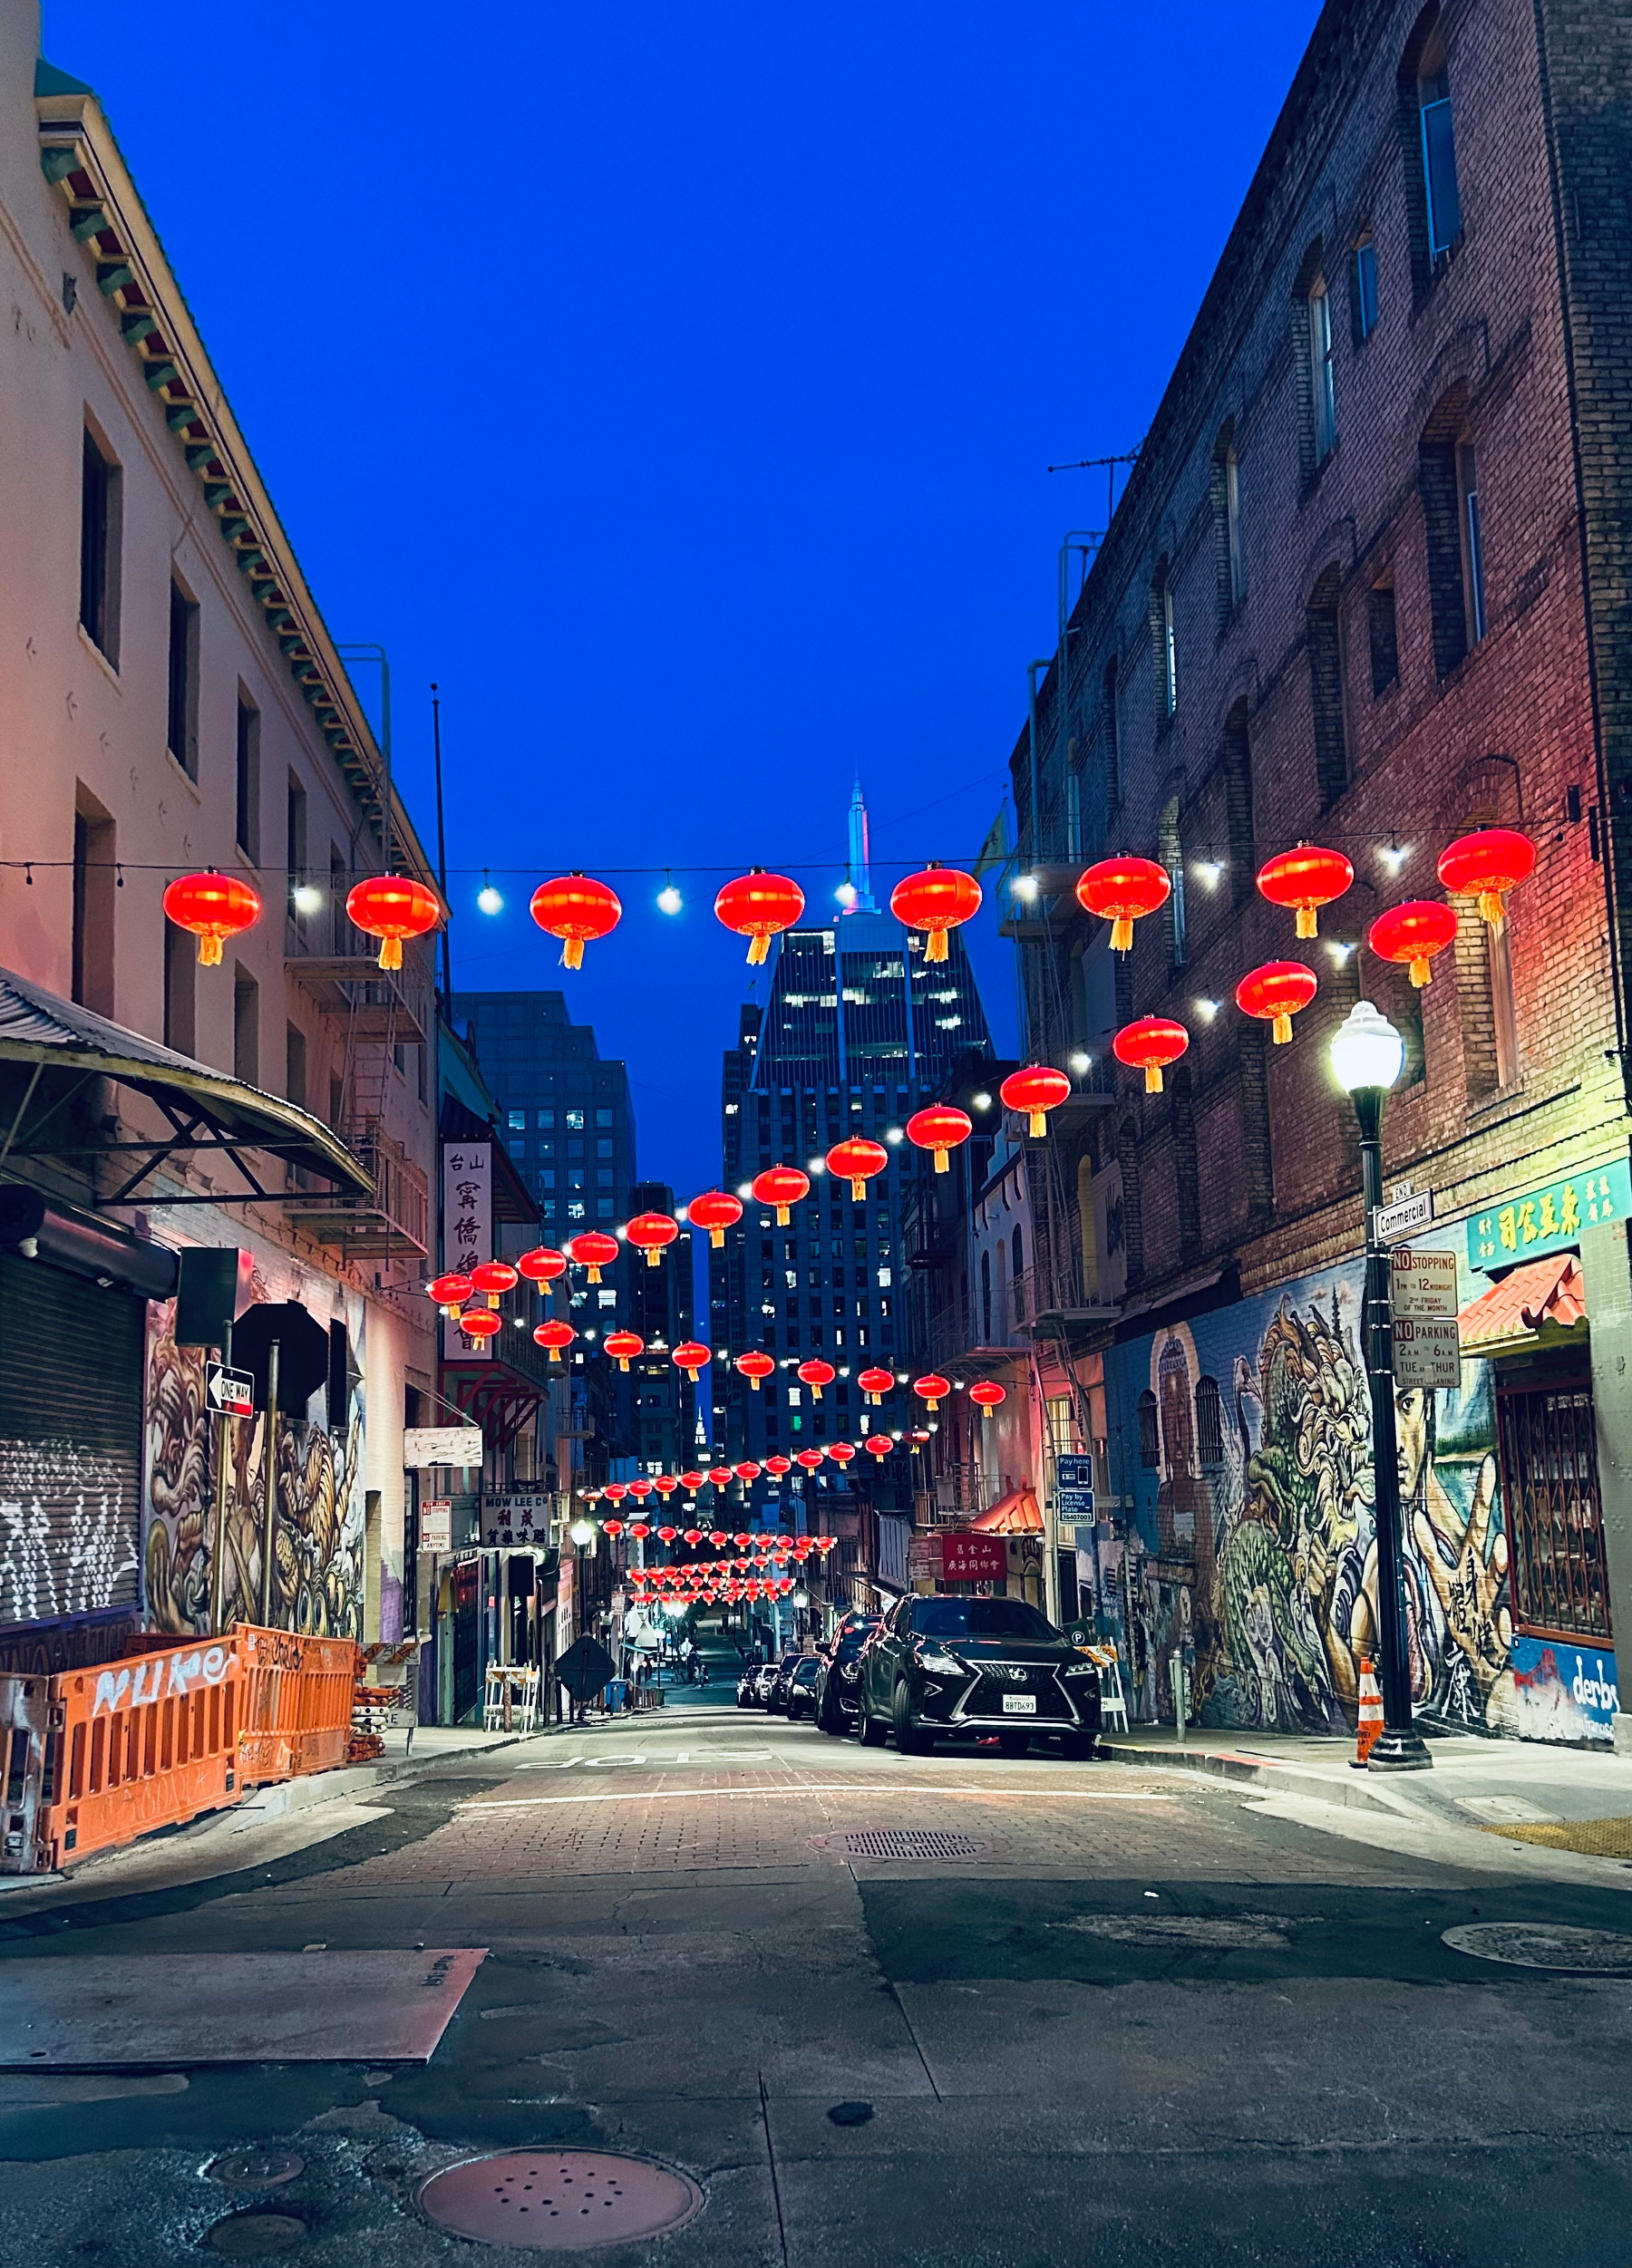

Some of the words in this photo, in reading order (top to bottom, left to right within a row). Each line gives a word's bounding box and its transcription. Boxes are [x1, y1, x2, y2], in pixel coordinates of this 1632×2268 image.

[1394, 1184, 1408, 1199] END
[1380, 1198, 1427, 1233] Commercial
[1394, 1253, 1410, 1269] NO
[1412, 1256, 1454, 1270] STOPPING
[1396, 1323, 1413, 1339] NO
[1415, 1326, 1456, 1340] PARKING
[1400, 1362, 1417, 1373] TUE
[221, 1380, 234, 1400] ONE
[236, 1384, 249, 1402] WAY
[1060, 1458, 1073, 1466] Pay
[485, 1497, 511, 1507] MOW
[515, 1497, 532, 1507] LEE
[423, 1507, 431, 1515] NO
[1573, 1655, 1620, 1713] derby
[1005, 1701, 1034, 1711] 8BTD693
[514, 1751, 773, 1769] STOP
